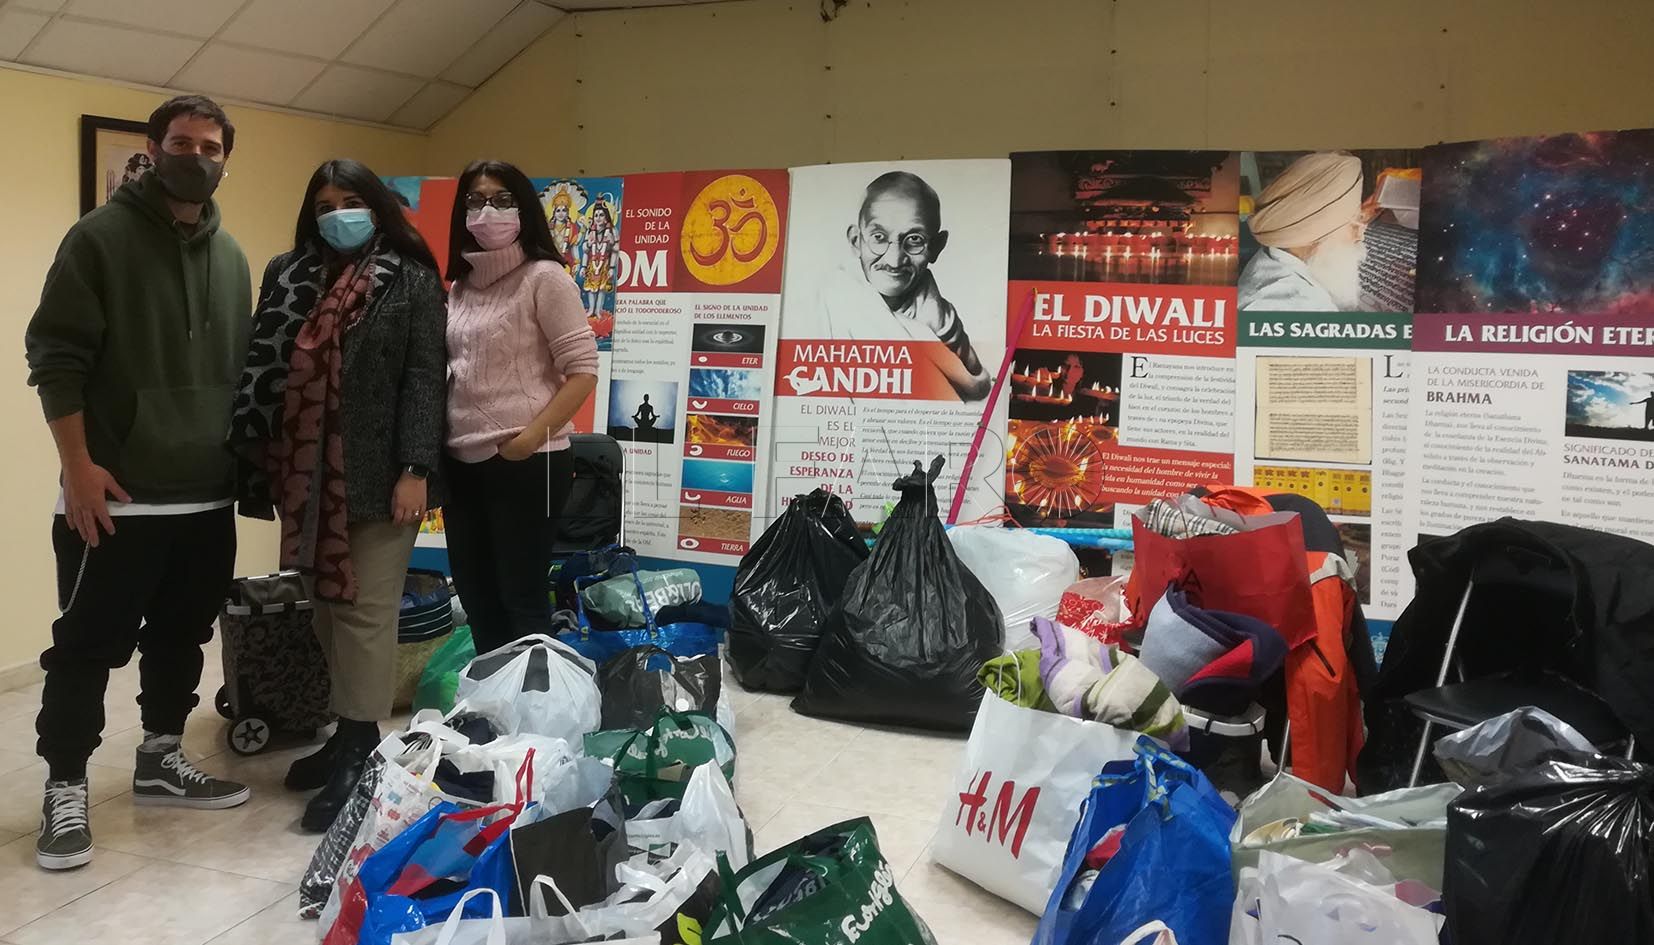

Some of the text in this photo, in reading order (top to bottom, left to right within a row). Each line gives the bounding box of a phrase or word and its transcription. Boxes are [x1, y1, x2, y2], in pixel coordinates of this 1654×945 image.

[626, 207, 672, 218] EL SONIDO
[645, 221, 670, 230] DE LA
[634, 234, 670, 244] UNIDAD
[1034, 294, 1226, 328] EL DIWALI
[1032, 324, 1224, 345] LA FIESTA DE LAS LUCES
[1249, 322, 1285, 337] LAS
[1290, 323, 1397, 339] SAGRADAS
[1445, 324, 1473, 342] LA
[1481, 320, 1594, 344] RELIGIÓN
[793, 344, 913, 365] MAHATMA
[741, 357, 758, 365] ETER
[1443, 367, 1496, 377] CONDUCTA
[1500, 367, 1538, 377] VENIDA
[783, 366, 912, 396] GANDHI
[1427, 378, 1544, 390] DE LA MISERICORDIA DE
[1427, 391, 1492, 405] BRAHMA
[732, 403, 754, 411] CIELO
[800, 404, 856, 416] EL DIWALI
[827, 421, 854, 432] ES EL
[819, 436, 856, 447] MEJOR
[726, 449, 751, 457] FUEGO
[1564, 443, 1654, 458] SIGNIFICADO DE
[801, 451, 836, 462] DESEO
[840, 453, 854, 463] DE
[1110, 452, 1131, 461] Diwali
[1146, 454, 1159, 463] trae
[1171, 458, 1199, 468] mensaje
[1563, 454, 1640, 469] SANATAMA
[790, 466, 853, 479] ESPERANZA
[1109, 463, 1142, 474] necesidad
[1144, 466, 1154, 474] del
[1156, 466, 1183, 476] hombre
[1194, 469, 1210, 478] vivir
[1126, 476, 1164, 487] humanidad
[1165, 480, 1184, 488] como
[839, 484, 853, 494] LA
[725, 496, 747, 504] AGUA
[720, 544, 744, 552] TIERRA
[955, 768, 1041, 860] H&M
